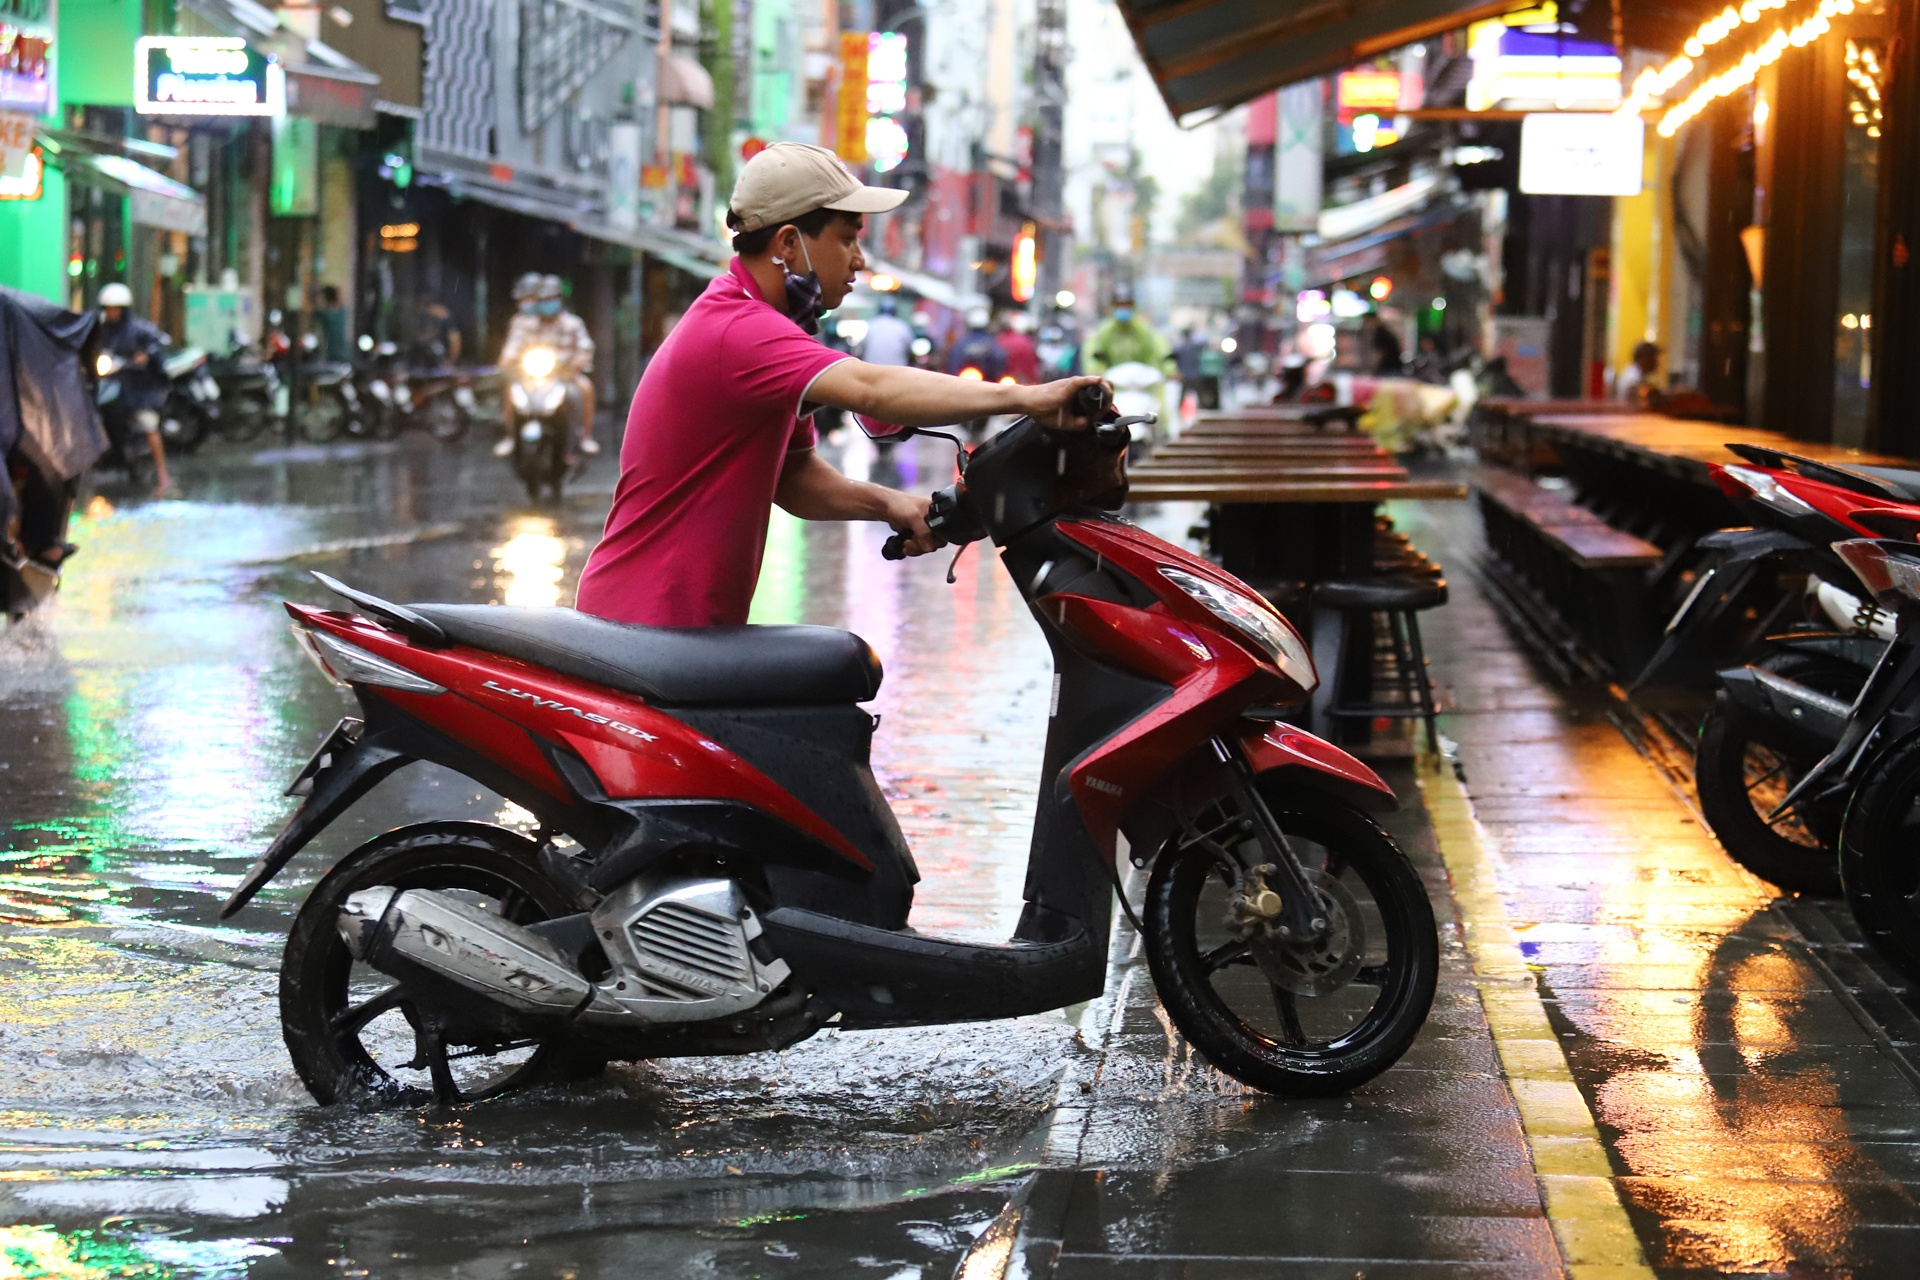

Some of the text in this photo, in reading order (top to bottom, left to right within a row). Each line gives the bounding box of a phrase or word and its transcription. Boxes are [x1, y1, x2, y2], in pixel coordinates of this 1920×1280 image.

[482, 680, 660, 743] LUVIAS GTX
[1085, 775, 1124, 797] YAMAHA
[659, 965, 728, 996] LUVIAS
